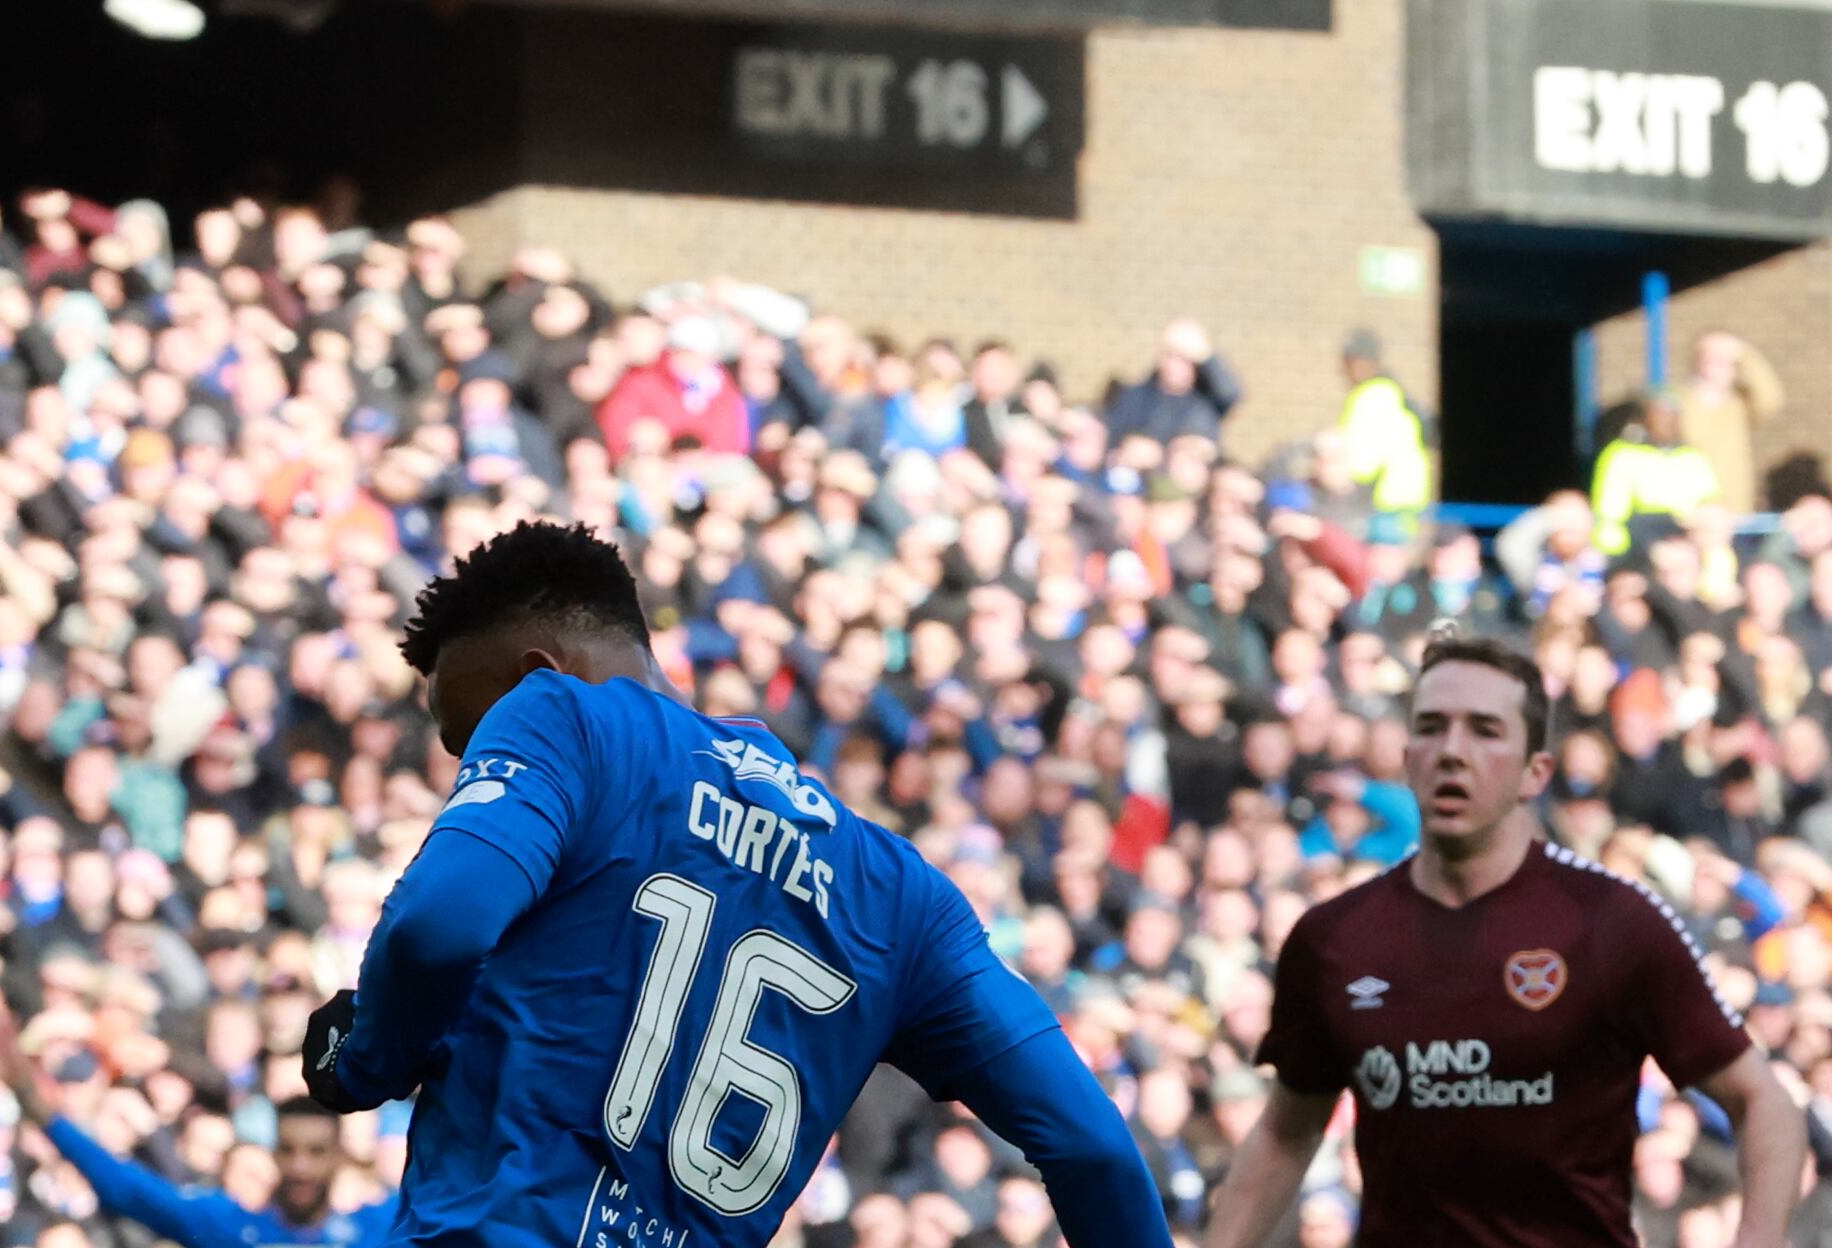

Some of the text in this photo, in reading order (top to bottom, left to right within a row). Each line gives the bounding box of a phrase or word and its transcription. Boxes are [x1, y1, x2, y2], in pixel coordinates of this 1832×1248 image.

[736, 50, 989, 147] EXIT 16
[1532, 65, 1830, 188] EXIT 16
[603, 871, 859, 1217] 16
[1405, 1038, 1491, 1075] MND
[1409, 1071, 1553, 1109] Scotland
